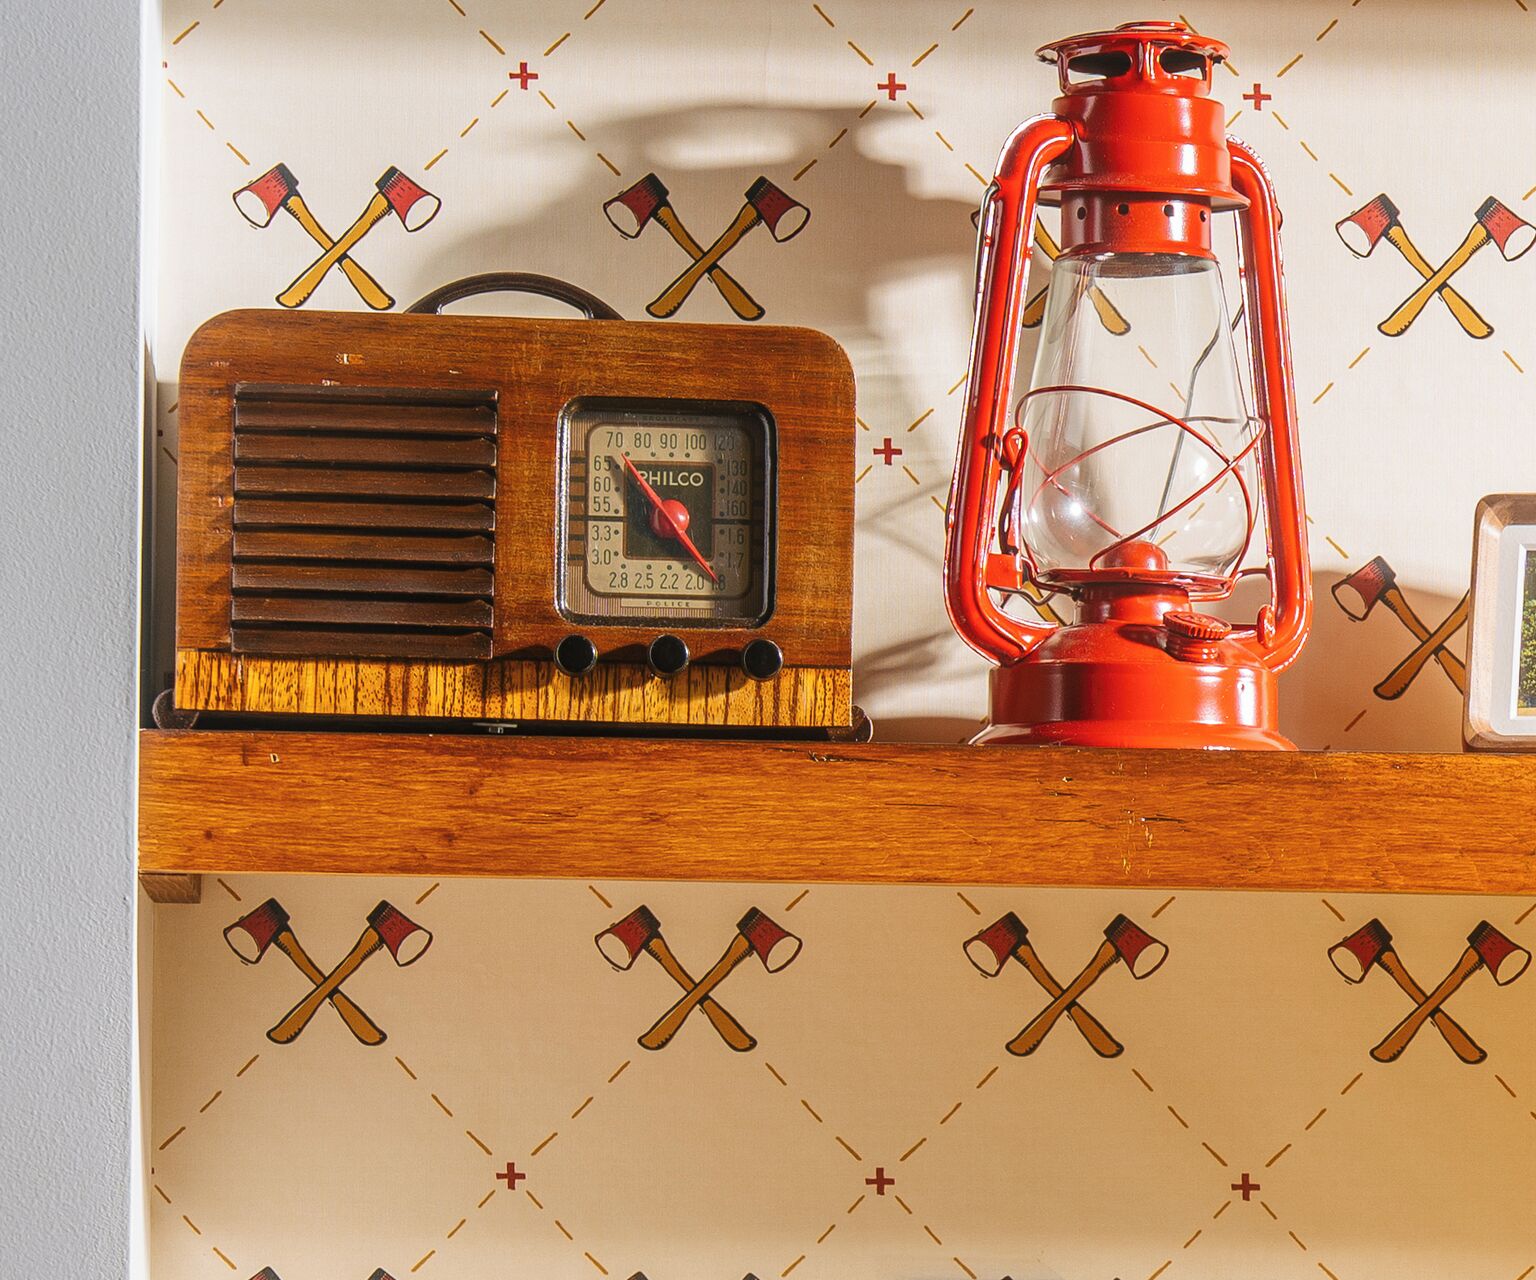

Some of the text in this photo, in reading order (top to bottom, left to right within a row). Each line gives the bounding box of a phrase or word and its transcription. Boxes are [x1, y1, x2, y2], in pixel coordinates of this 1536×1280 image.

[606, 431, 623, 448] 70
[634, 432, 651, 448] 80
[660, 433, 677, 449] 90
[686, 433, 706, 450] 100
[594, 455, 611, 471] 65
[727, 460, 747, 476] 130
[594, 476, 611, 492] 60
[727, 480, 747, 496] 140
[593, 496, 610, 512] 55
[726, 500, 747, 517] 160
[592, 525, 611, 541] 3.3
[728, 528, 744, 544] 1.6
[592, 549, 611, 565] 3.0
[727, 552, 744, 568] 1.7
[609, 572, 628, 588] 2.8
[635, 573, 653, 589] 2.5
[660, 573, 678, 589] 2.2
[686, 574, 704, 590] 2.0
